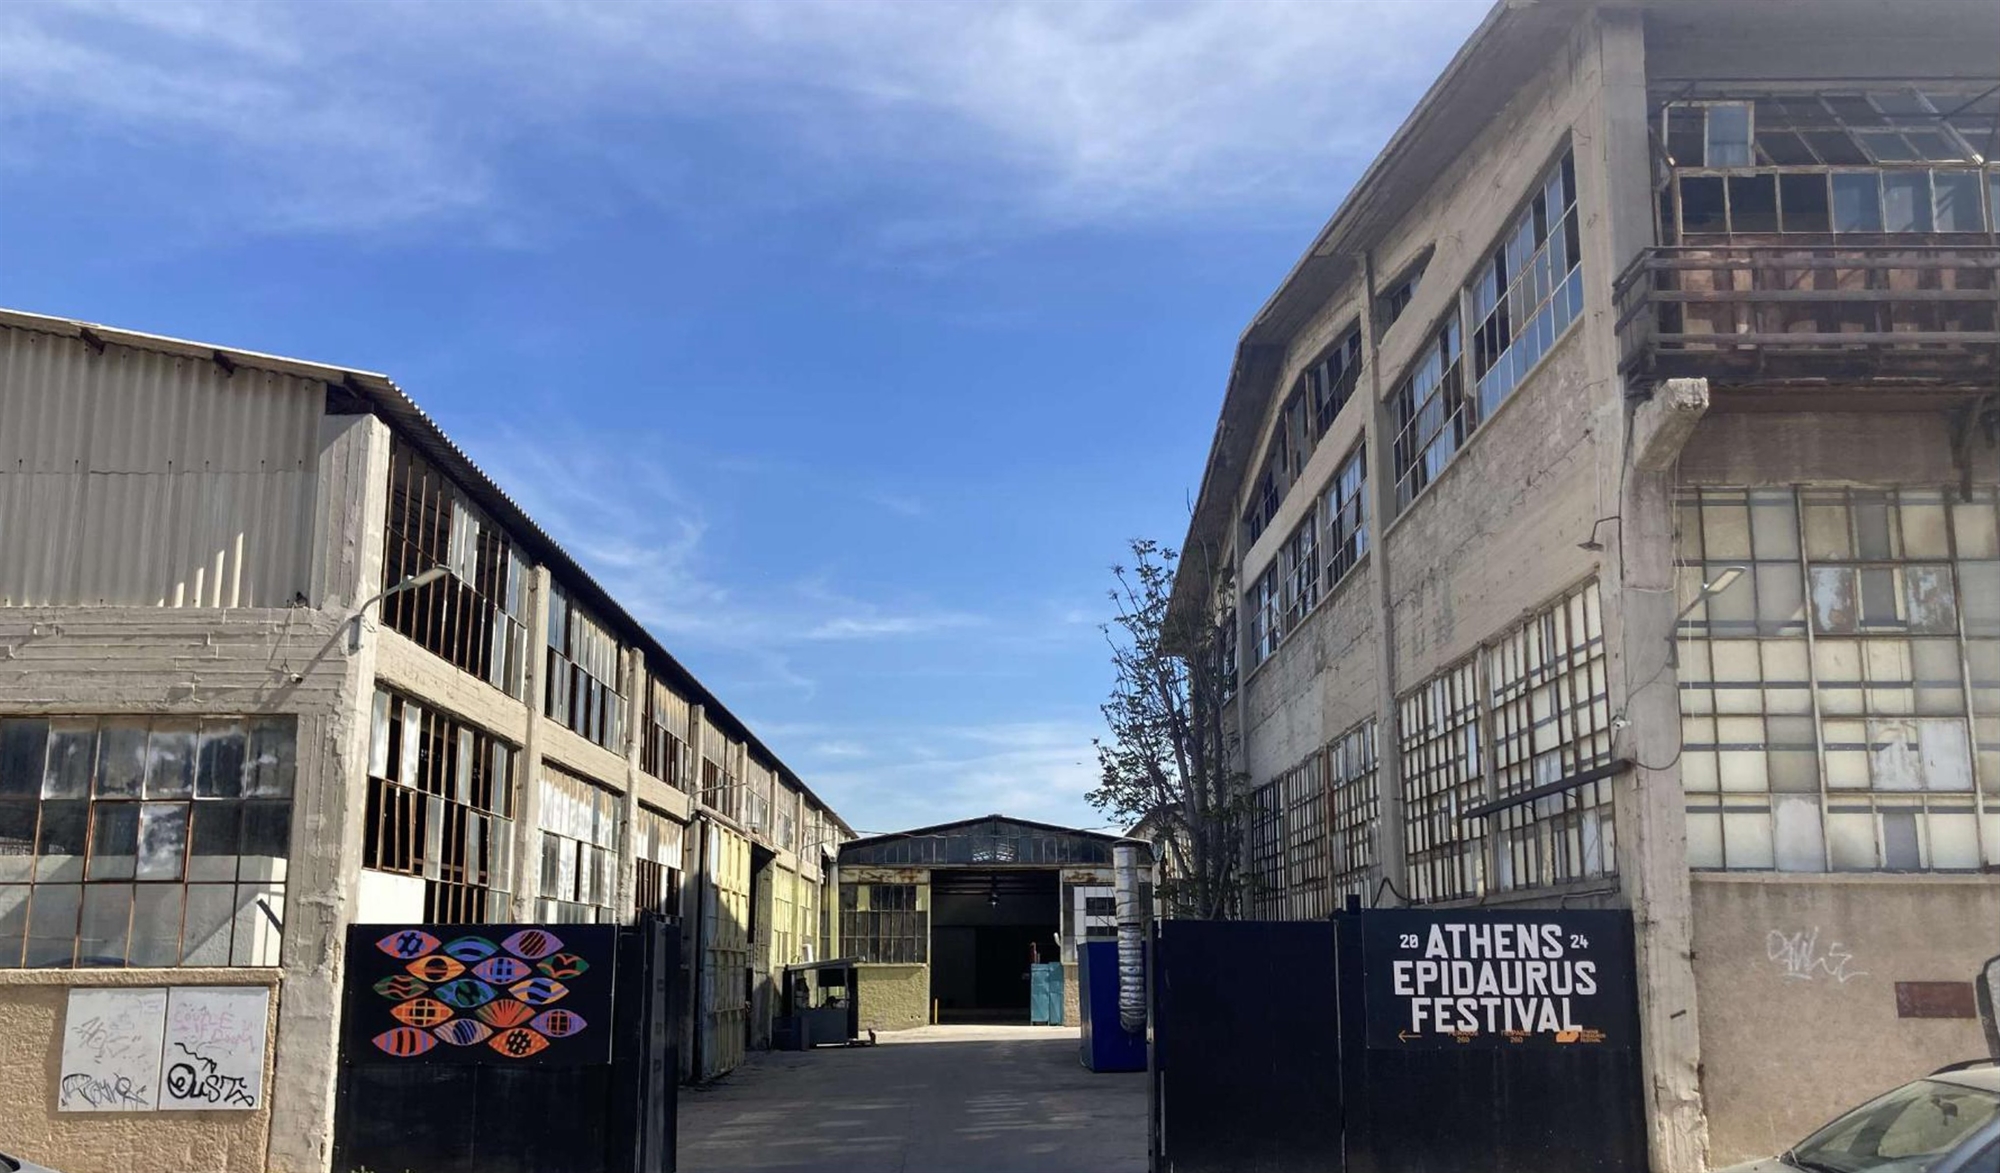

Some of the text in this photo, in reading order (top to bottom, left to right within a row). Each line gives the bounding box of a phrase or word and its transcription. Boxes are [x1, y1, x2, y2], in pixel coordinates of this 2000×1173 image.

[1400, 924, 1588, 959] 20 ATHENS 24
[1392, 960, 1597, 996] EPIDAURUS
[1411, 997, 1583, 1033] FESTIVAL
